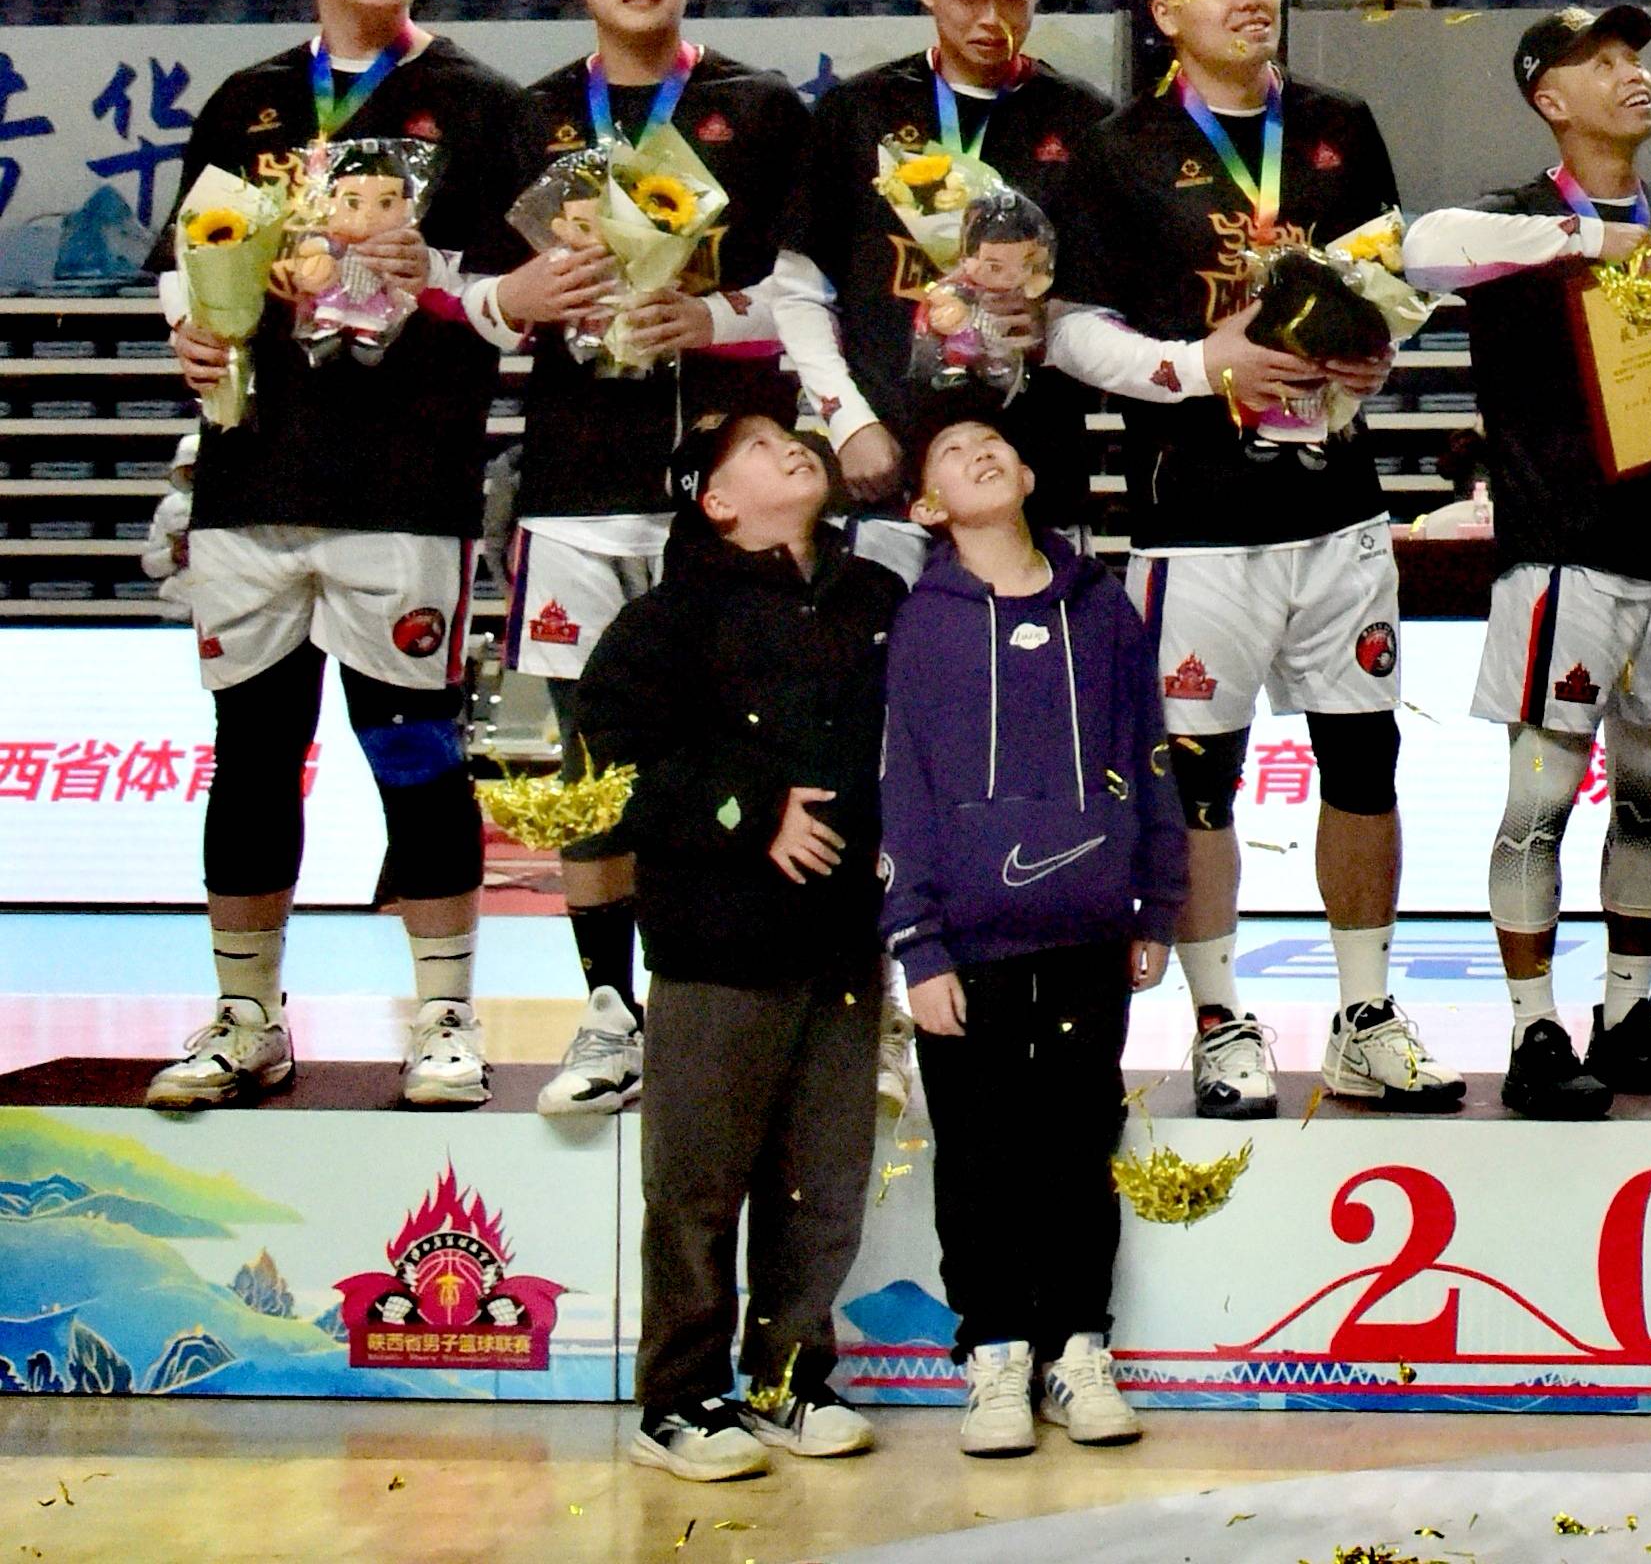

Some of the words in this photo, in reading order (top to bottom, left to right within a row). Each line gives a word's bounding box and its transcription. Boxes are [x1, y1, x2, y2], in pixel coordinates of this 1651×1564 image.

[367, 1332, 531, 1354] 陕西省男子篮球联赛
